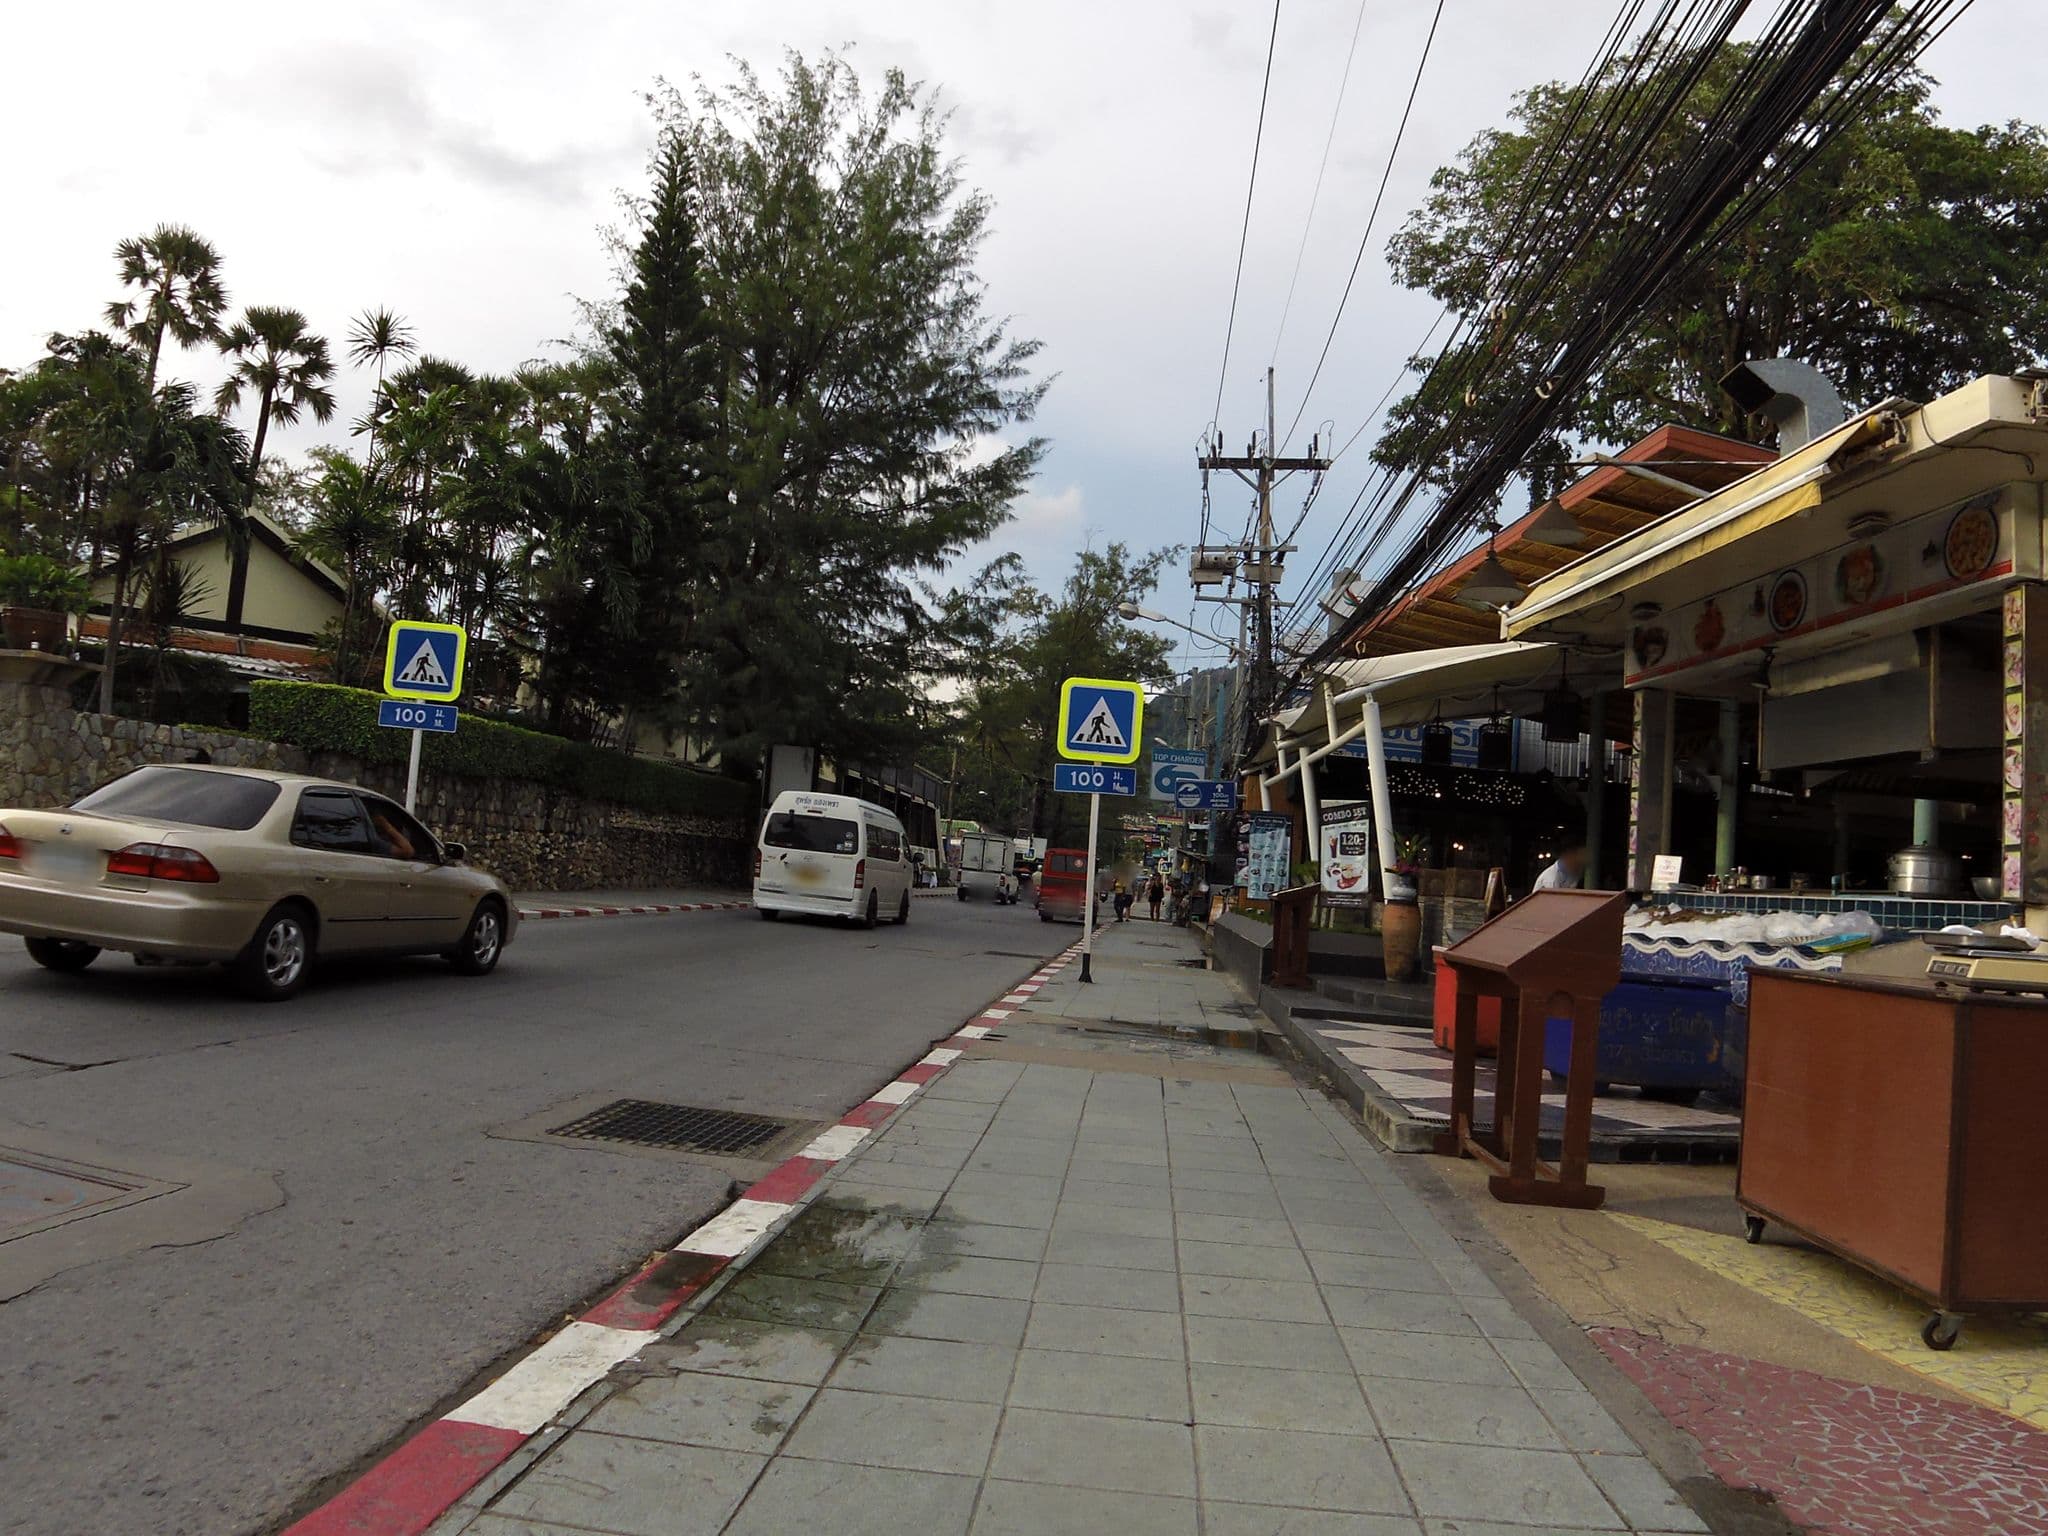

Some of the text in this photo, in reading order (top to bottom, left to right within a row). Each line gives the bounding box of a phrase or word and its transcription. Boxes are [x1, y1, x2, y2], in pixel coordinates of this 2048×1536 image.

[395, 708, 426, 724] 100
[1154, 753, 1169, 761] TOP
[1071, 771, 1105, 787] 100
[1322, 806, 1367, 822] COMBO SET
